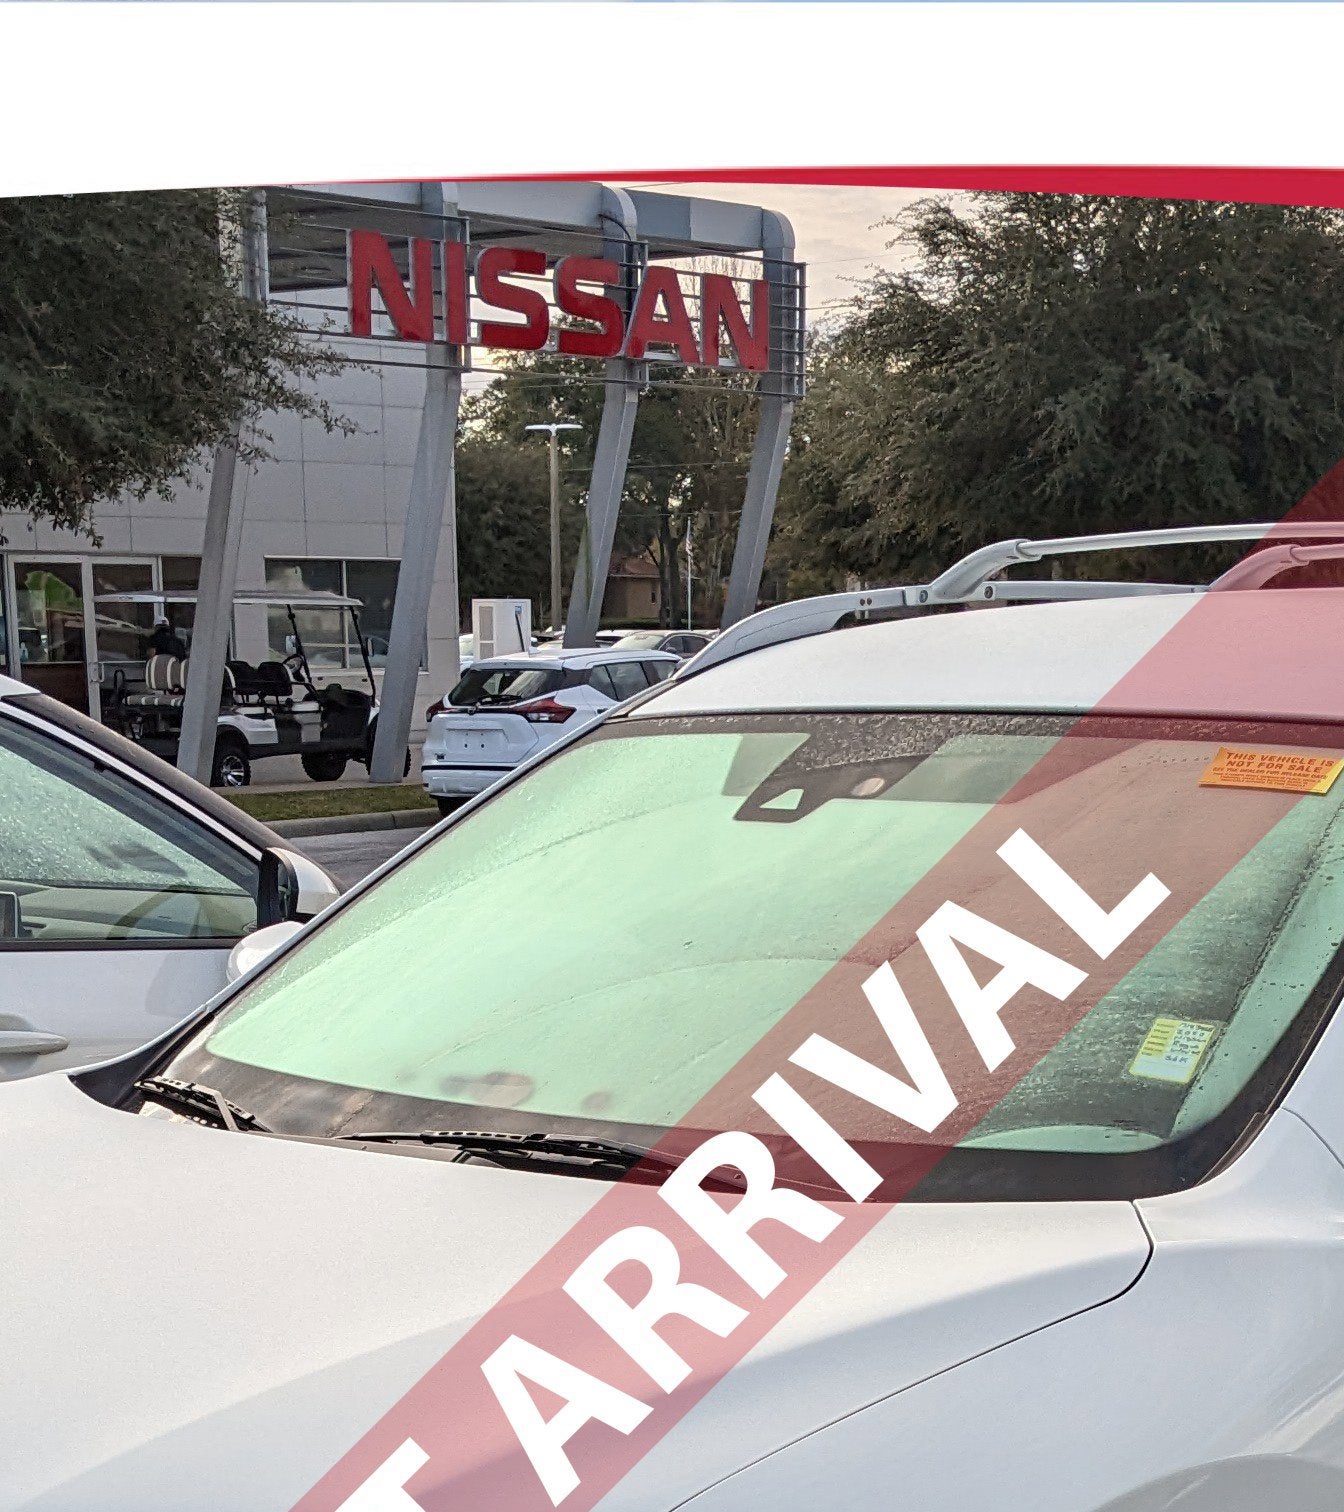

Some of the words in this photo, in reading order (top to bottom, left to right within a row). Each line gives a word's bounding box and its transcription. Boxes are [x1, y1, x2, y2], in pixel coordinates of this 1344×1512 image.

[347, 230, 769, 371] NISSAN
[1225, 760, 1252, 768] NOT
[1257, 762, 1284, 770] FOR
[1287, 764, 1323, 773] SALE
[1226, 752, 1256, 761] THIS
[1260, 754, 1317, 766] VEHICLE
[1321, 759, 1335, 767] IS
